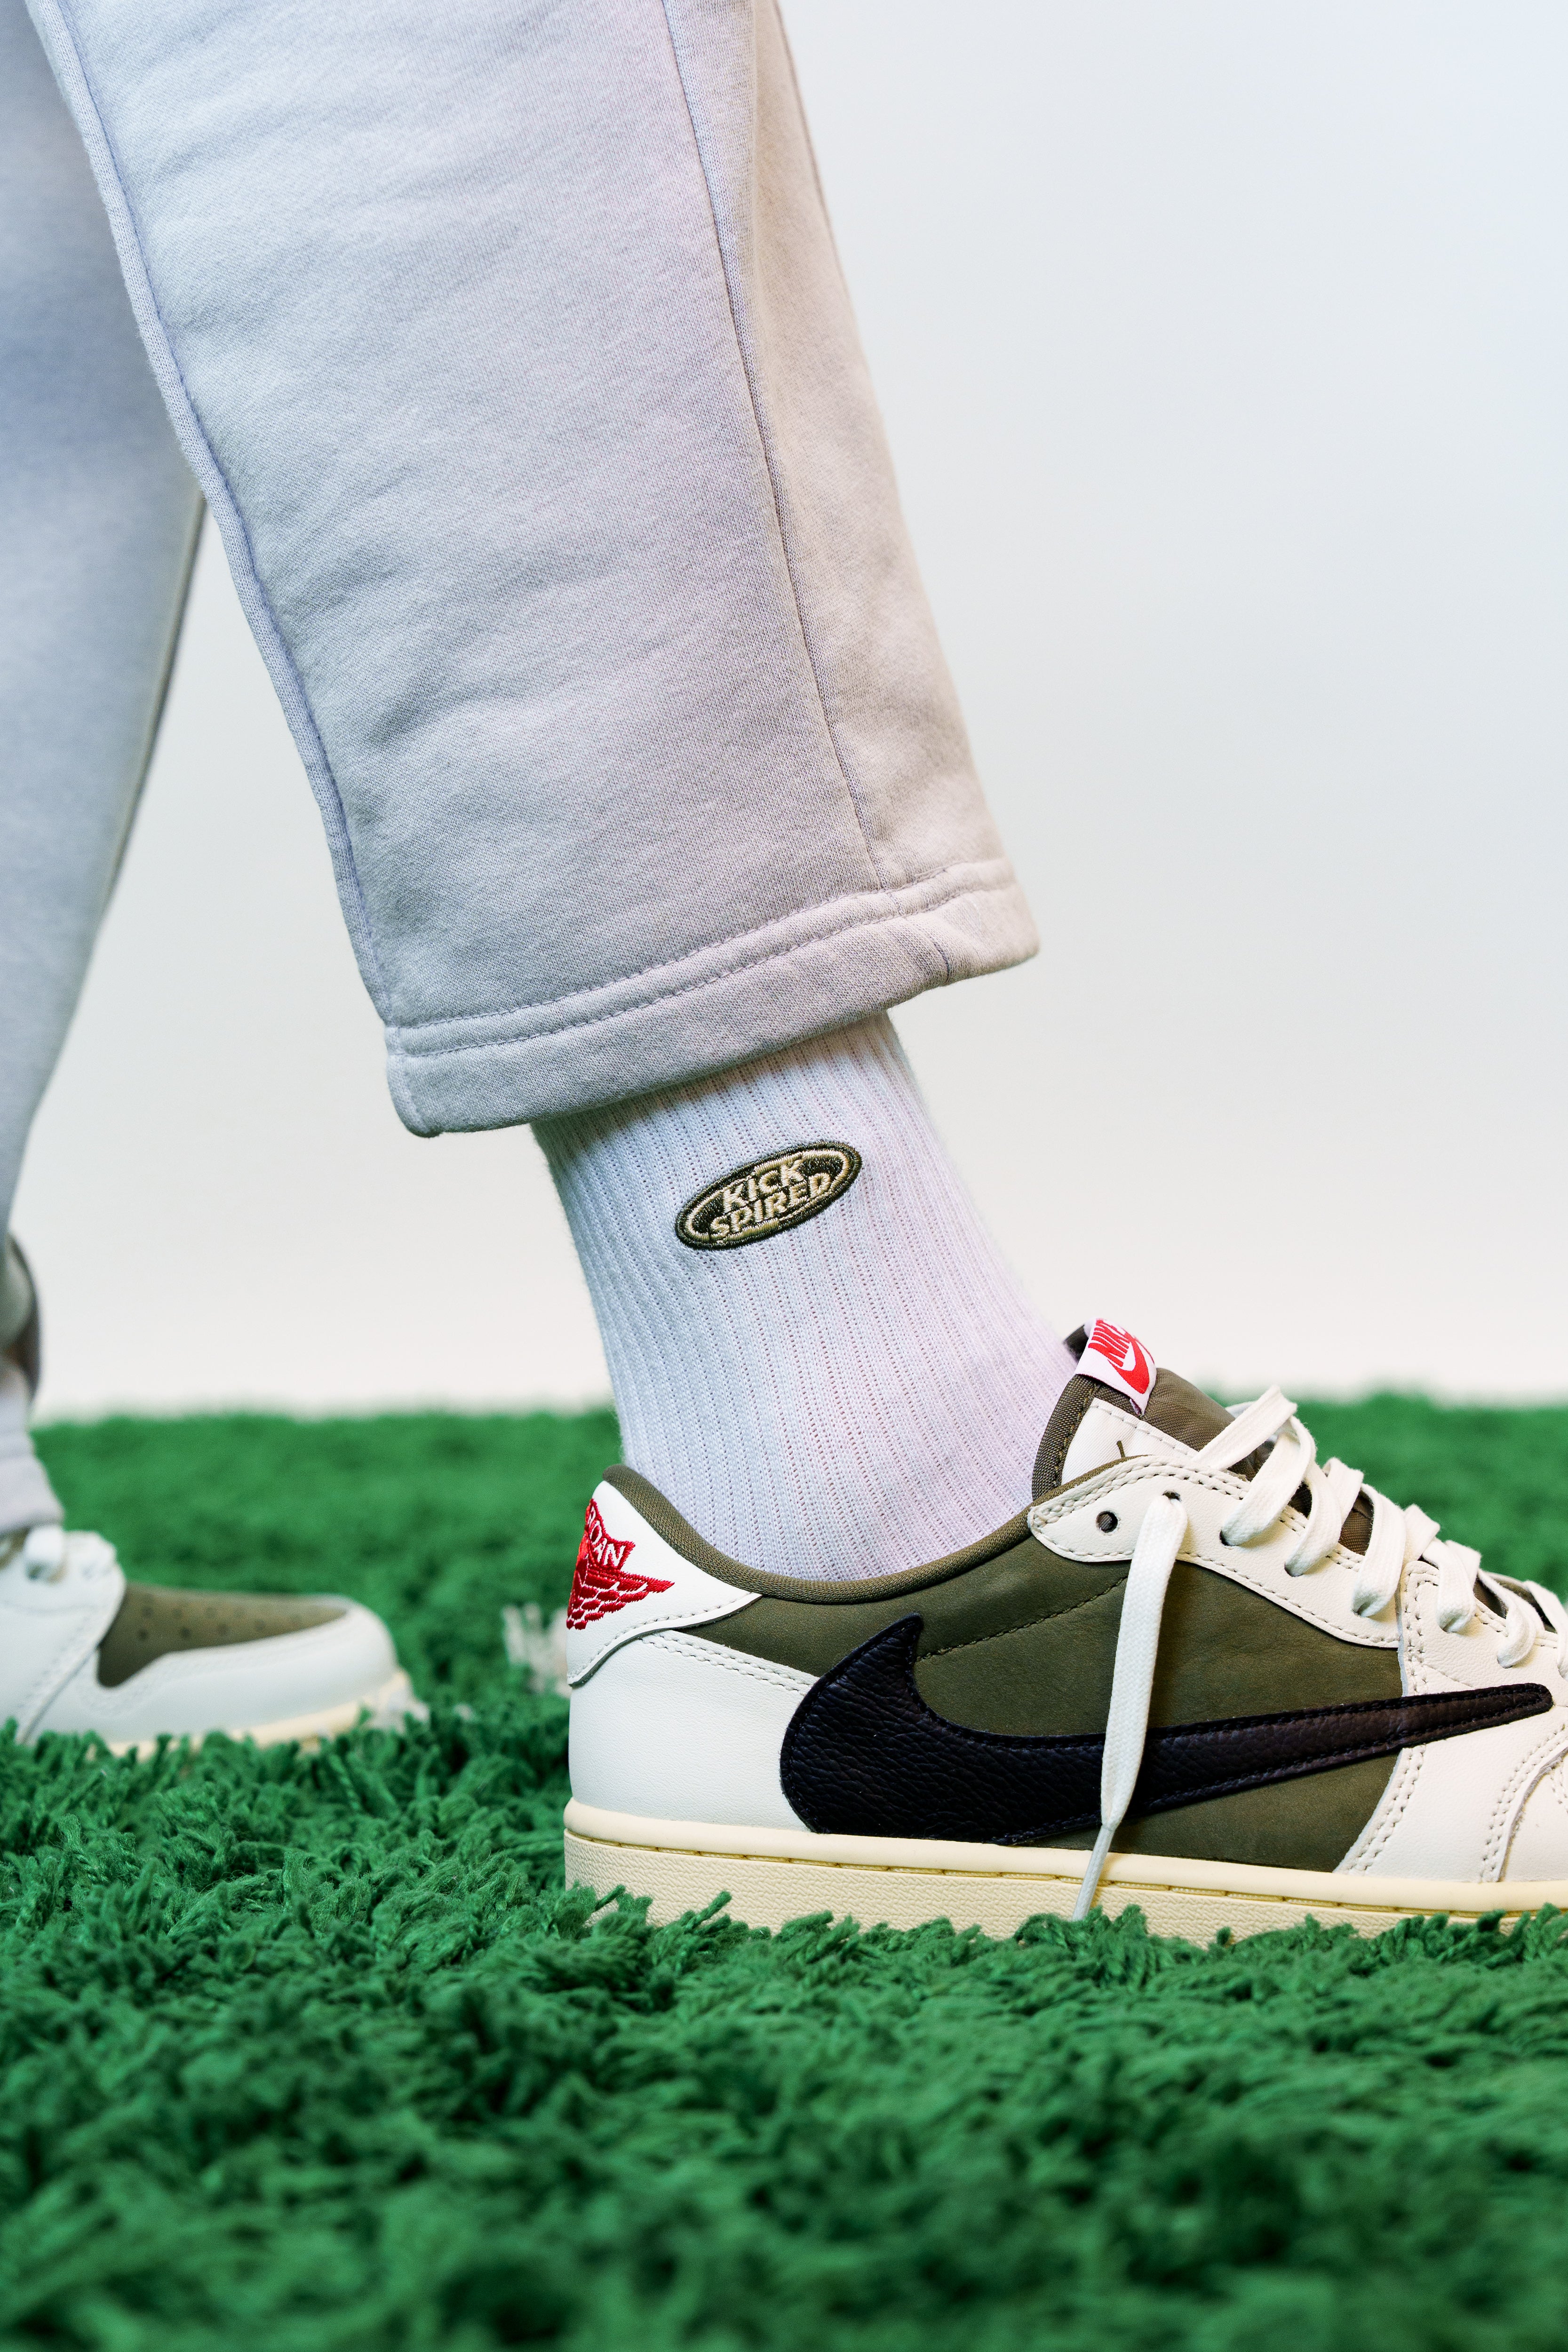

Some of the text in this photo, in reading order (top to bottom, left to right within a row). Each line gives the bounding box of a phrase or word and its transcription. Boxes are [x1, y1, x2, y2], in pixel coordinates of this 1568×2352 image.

[710, 1173, 831, 1237] SPIRED
[723, 1159, 804, 1213] KICK
[588, 1505, 626, 1567] RDAN
